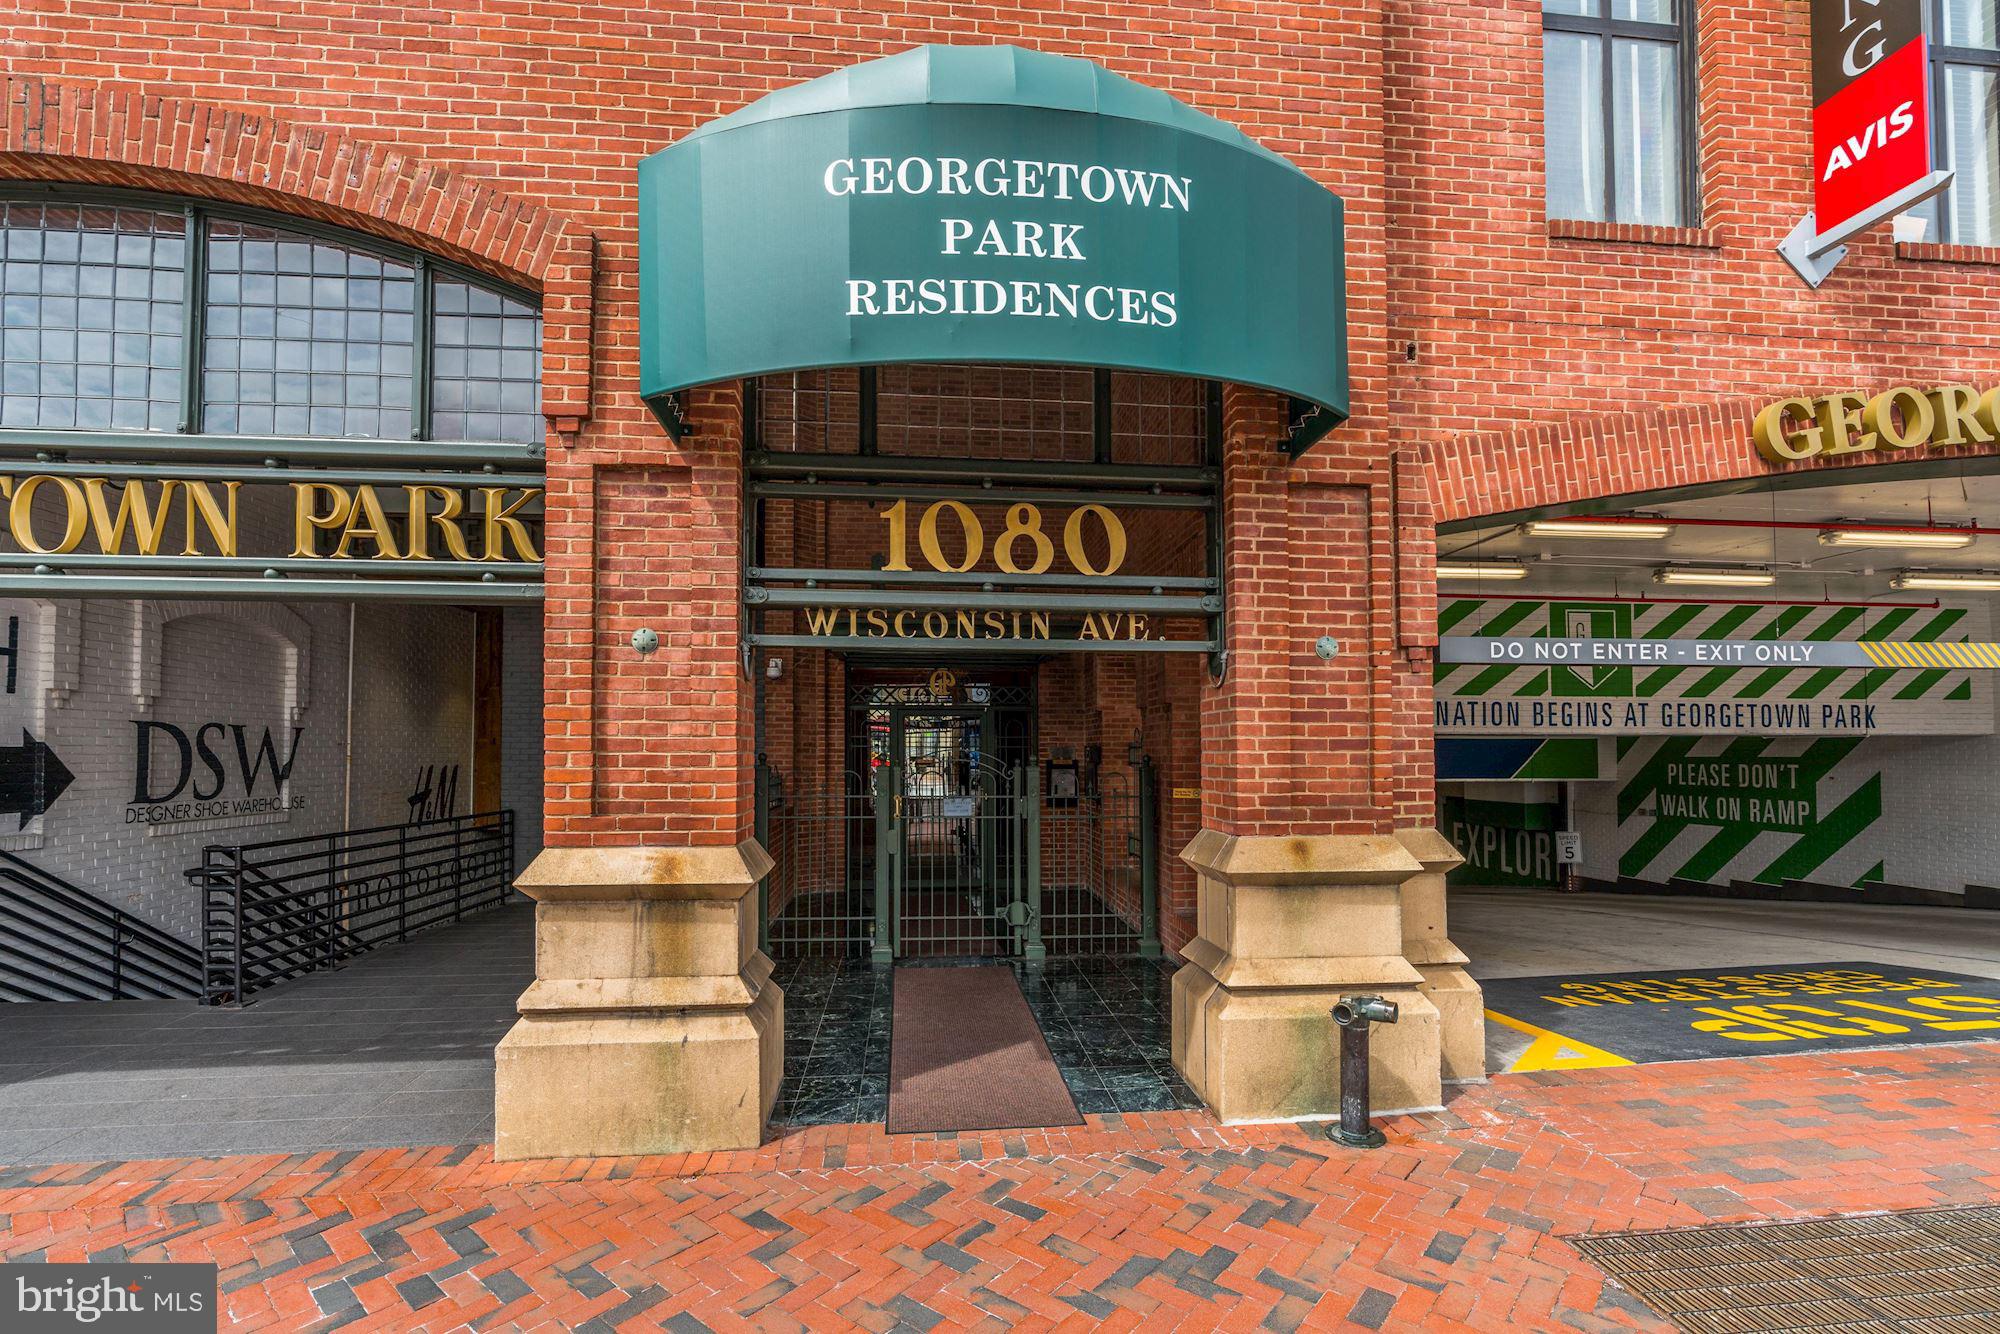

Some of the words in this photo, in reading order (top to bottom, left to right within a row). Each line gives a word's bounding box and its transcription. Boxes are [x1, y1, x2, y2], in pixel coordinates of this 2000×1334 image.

[1823, 100, 1914, 182] AVIS
[823, 157, 1192, 212] GEORGETOWN
[940, 218, 1087, 260] PARK
[845, 278, 1178, 327] RESIDENCES
[1753, 384, 2000, 465] GEOR
[0, 475, 243, 558] OWN
[288, 483, 545, 563] PARK
[879, 499, 1128, 576] 1080
[803, 607, 1051, 640] WISCONSIN
[1078, 613, 1167, 642] AVE.
[1490, 641, 1524, 659] DO
[1535, 642, 1582, 660] NOT
[1593, 643, 1668, 661] ENTER
[1695, 644, 1745, 661] EXIT
[1755, 644, 1814, 662] ONLY
[1436, 701, 1519, 727] NATION
[1533, 702, 1613, 728] BEGINS
[1625, 703, 1648, 727] AT
[1662, 703, 1810, 728] GEORGETOWN
[1823, 704, 1876, 729] PARK
[127, 719, 305, 804] DSW
[1667, 763, 1730, 787] PLEASE
[1738, 764, 1799, 789] DON'T
[194, 801, 229, 818] SHOE
[407, 765, 459, 830] H&M
[1661, 794, 1709, 819] WALK
[1716, 797, 1741, 821] ON
[1750, 799, 1810, 825] RAMP
[1453, 821, 1560, 882] EXPLOR
[1565, 847, 1575, 859] 5
[1541, 977, 1962, 1008] PEDESTRIAN
[1560, 970, 1885, 994] CROSSING
[1691, 995, 2000, 1041] STOP
